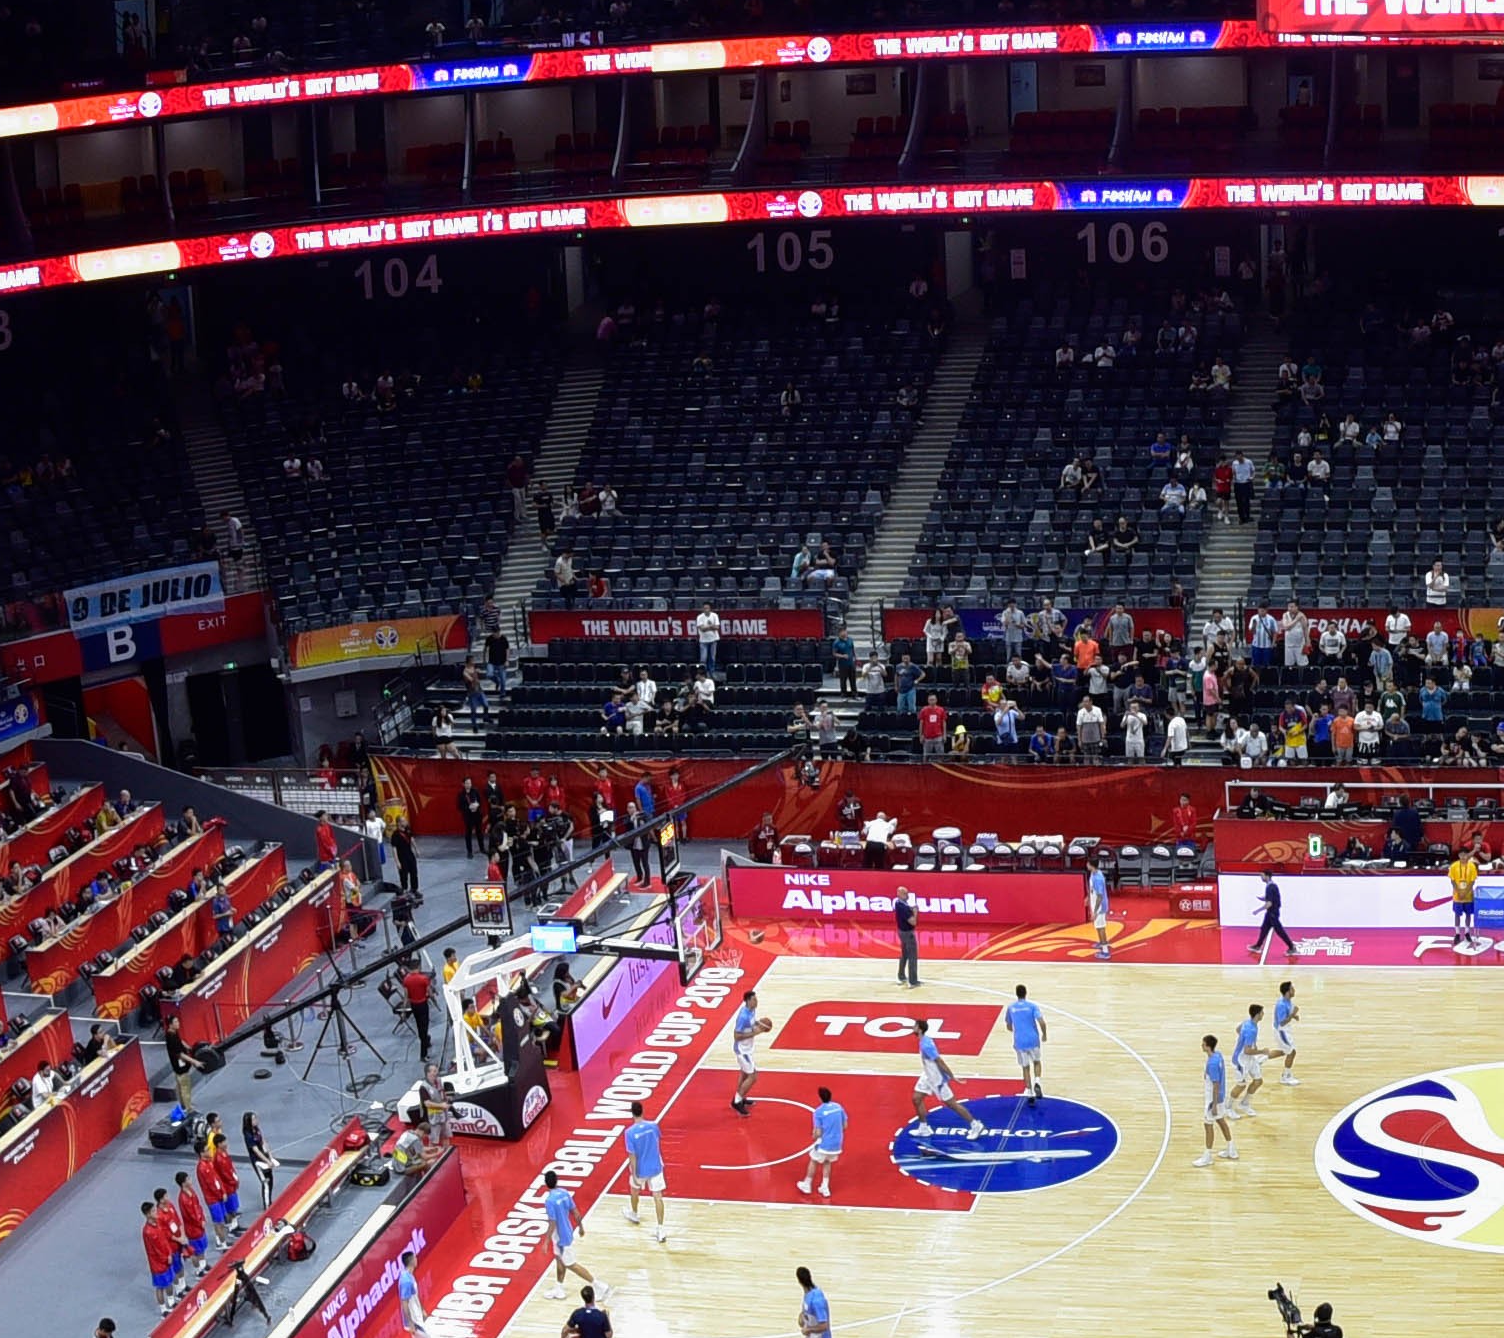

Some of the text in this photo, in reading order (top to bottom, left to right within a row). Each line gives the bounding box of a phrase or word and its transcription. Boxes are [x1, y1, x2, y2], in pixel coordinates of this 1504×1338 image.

[1226, 185, 1255, 202] THE
[1261, 180, 1334, 202] WORLD'S
[1376, 183, 1424, 200] GAME
[747, 230, 833, 271] 105
[1078, 221, 1168, 263] 106
[352, 251, 442, 299] 104
[72, 573, 212, 622] 9 DE JULIO
[198, 615, 227, 631] EXIT
[582, 616, 767, 637] THE WORLD'S GAME
[106, 625, 136, 662] B
[784, 874, 830, 886] NIKE
[481, 927, 513, 936] TISSOT
[815, 1014, 961, 1040] TCL
[585, 1051, 678, 1121] WORLD
[645, 1011, 706, 1047] CUP
[685, 966, 744, 1009] 2019
[930, 1127, 1053, 1138] ERFLOT
[321, 1287, 348, 1326] NIKE
